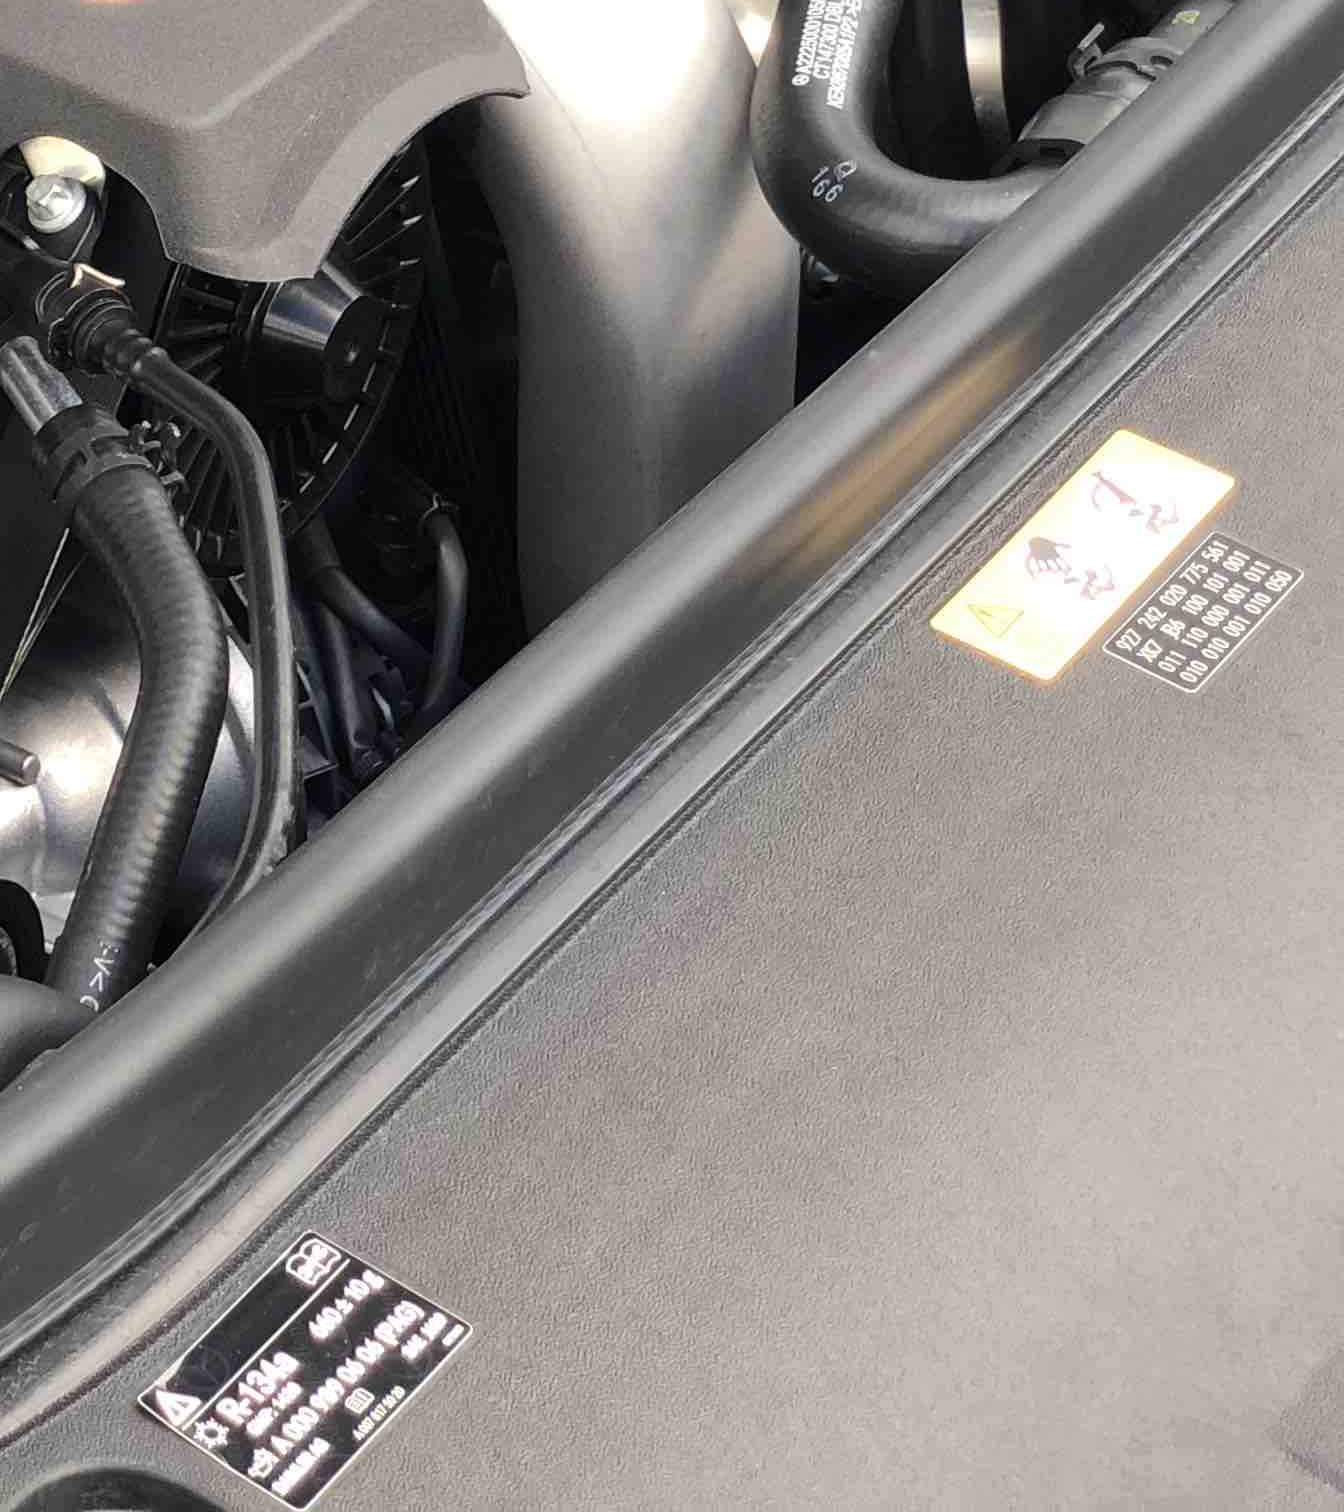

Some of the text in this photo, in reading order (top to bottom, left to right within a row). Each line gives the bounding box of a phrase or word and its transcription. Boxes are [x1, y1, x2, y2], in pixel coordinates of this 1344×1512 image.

[1116, 628, 1141, 651] 927
[1160, 585, 1187, 606] 020
[1179, 562, 1208, 584] 775
[1201, 541, 1228, 562] 561
[1158, 561, 1270, 672] 011 110 000 001 011
[1180, 570, 1292, 682] 010 010 001 010 050
[1182, 595, 1208, 615] 100
[1203, 573, 1228, 593] 101
[1223, 551, 1249, 572] 001
[216, 1353, 299, 1425] R-134a
[344, 1279, 374, 1301] 10
[271, 1436, 294, 1455] A
